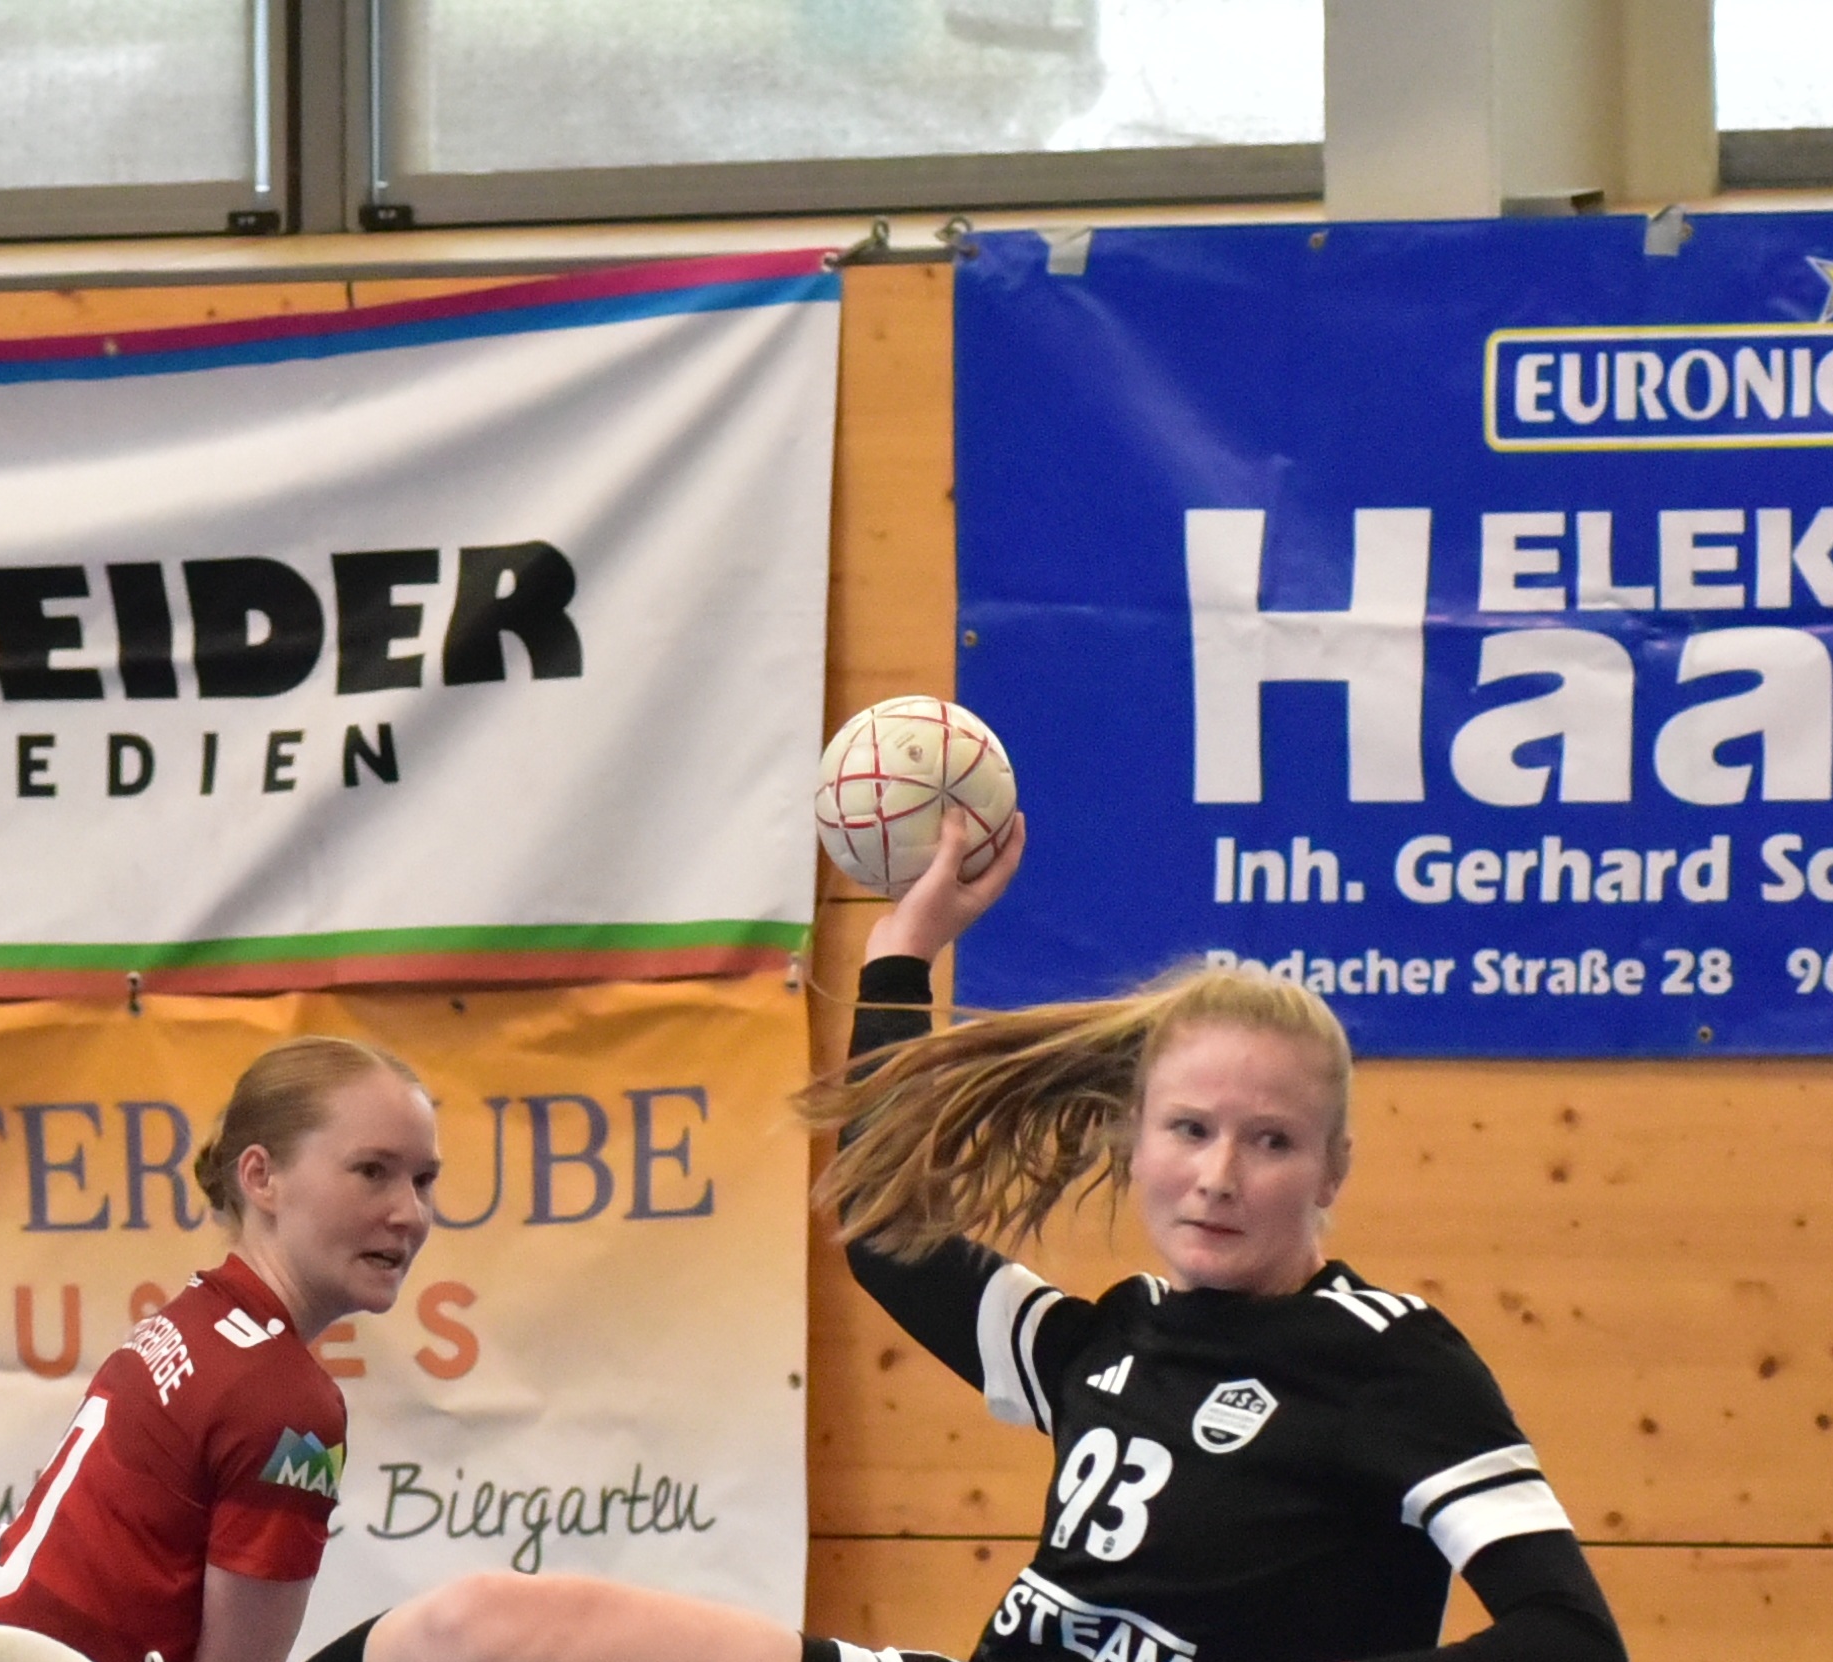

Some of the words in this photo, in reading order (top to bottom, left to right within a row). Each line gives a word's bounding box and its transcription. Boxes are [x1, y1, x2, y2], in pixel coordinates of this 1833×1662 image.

[1213, 836, 1365, 903] Inh.
[1393, 834, 1731, 904] Gerhard
[1471, 948, 1646, 997] Straße
[1660, 948, 1734, 996] 28
[366, 1462, 716, 1575] Biergarten
[1050, 1426, 1174, 1563] 93
